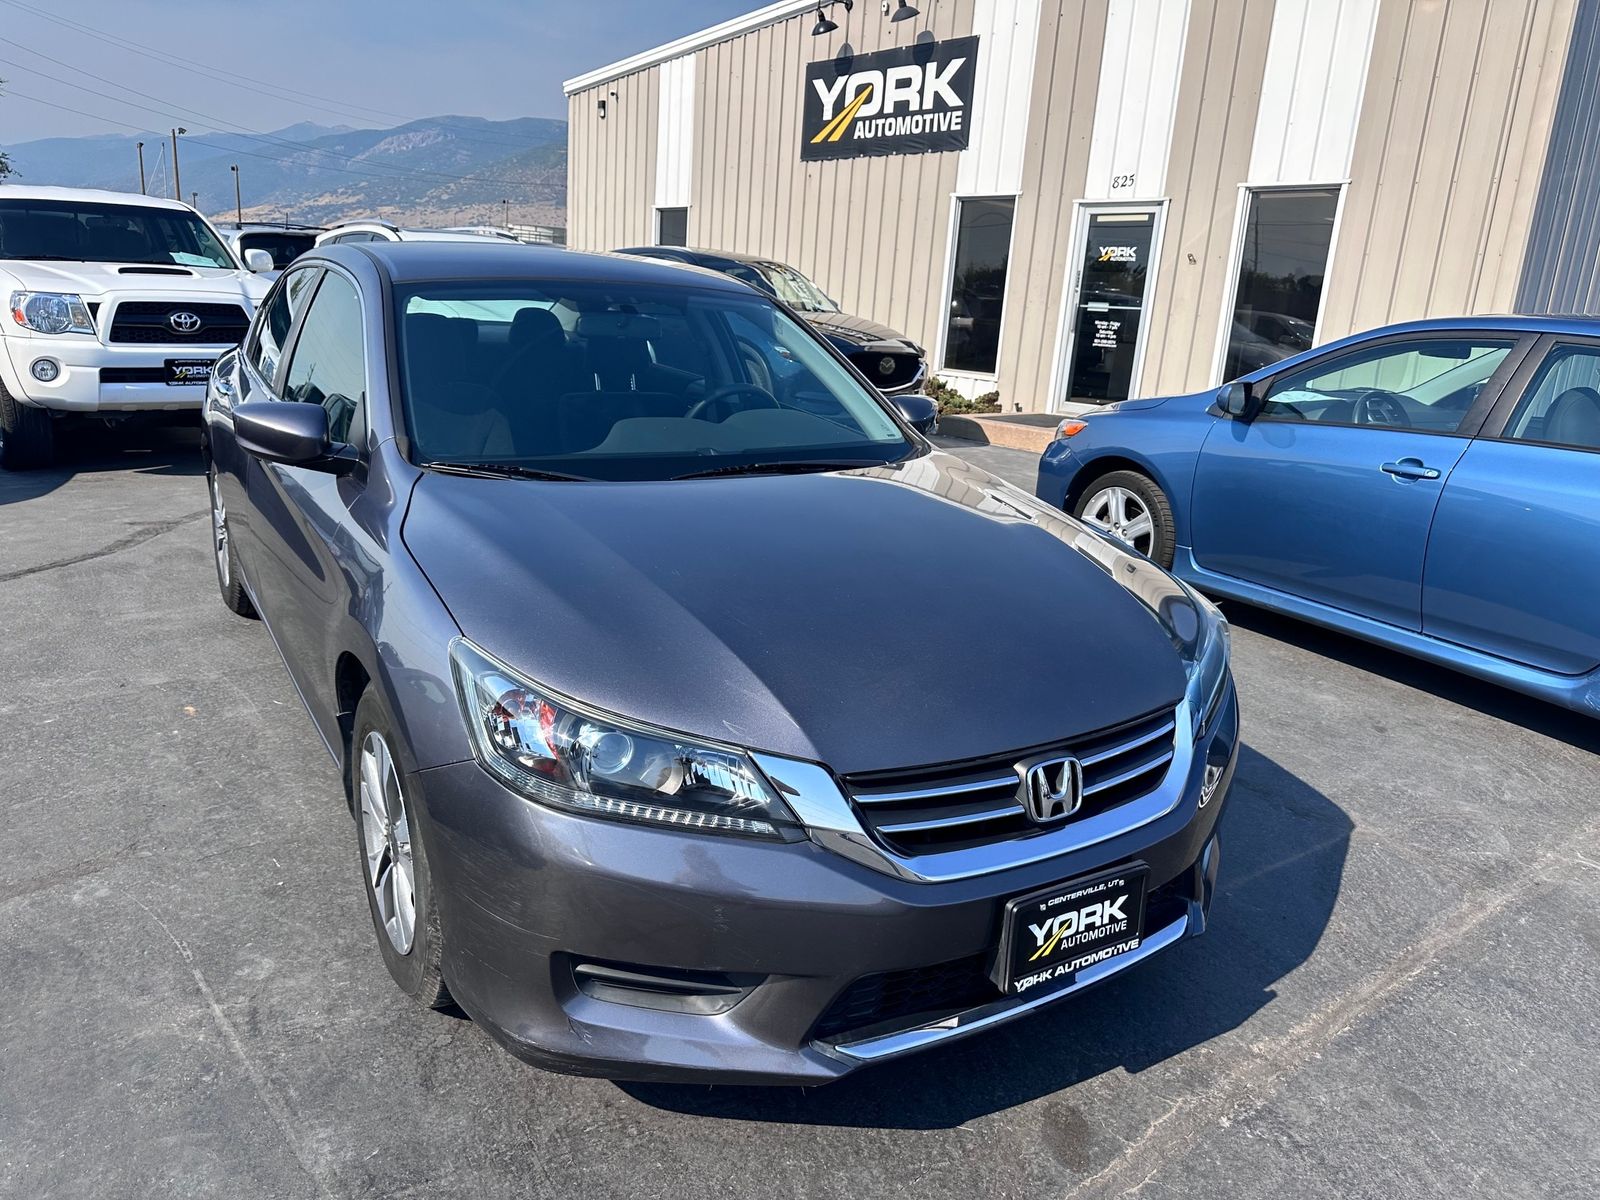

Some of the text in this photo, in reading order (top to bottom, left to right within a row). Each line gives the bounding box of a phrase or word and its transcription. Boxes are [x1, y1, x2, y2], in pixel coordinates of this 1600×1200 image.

[812, 57, 966, 120] YORK
[853, 110, 962, 139] AUTOMOTIVE
[1112, 174, 1135, 188] 825
[1099, 246, 1137, 256] YORK
[172, 366, 212, 374] YORK
[1048, 879, 1119, 906] CENTERVILLE, UT
[1028, 894, 1129, 947] YORK
[1060, 920, 1127, 950] AUTOMOTIVE
[1054, 938, 1139, 976] AUTOMOTIVE
